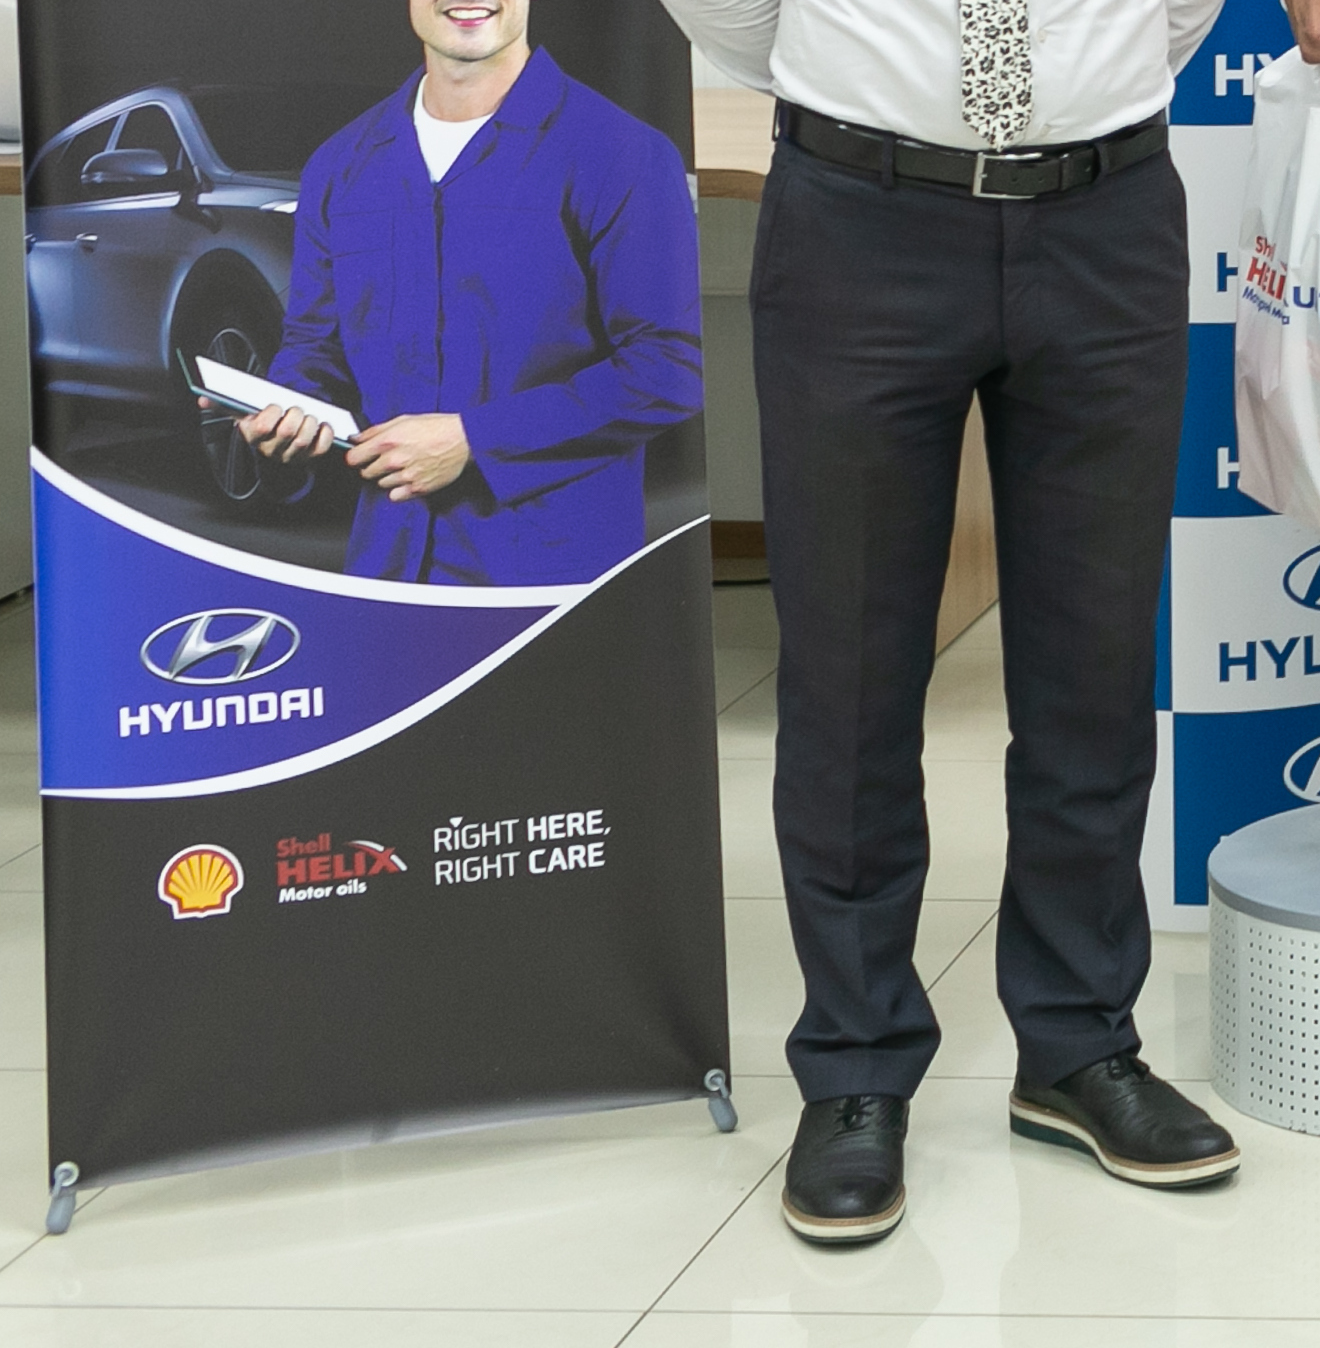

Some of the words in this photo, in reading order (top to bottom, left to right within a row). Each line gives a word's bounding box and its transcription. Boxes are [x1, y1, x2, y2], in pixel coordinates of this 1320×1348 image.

[119, 687, 325, 738] HYUNDAI
[276, 832, 332, 858] Shell
[434, 816, 520, 853] RIGHT
[527, 809, 612, 841] HERE,
[276, 844, 403, 888] HELIX
[434, 852, 521, 885] RIGHT
[528, 841, 606, 875] CARE
[278, 885, 333, 903] Motor
[336, 878, 367, 896] oils
